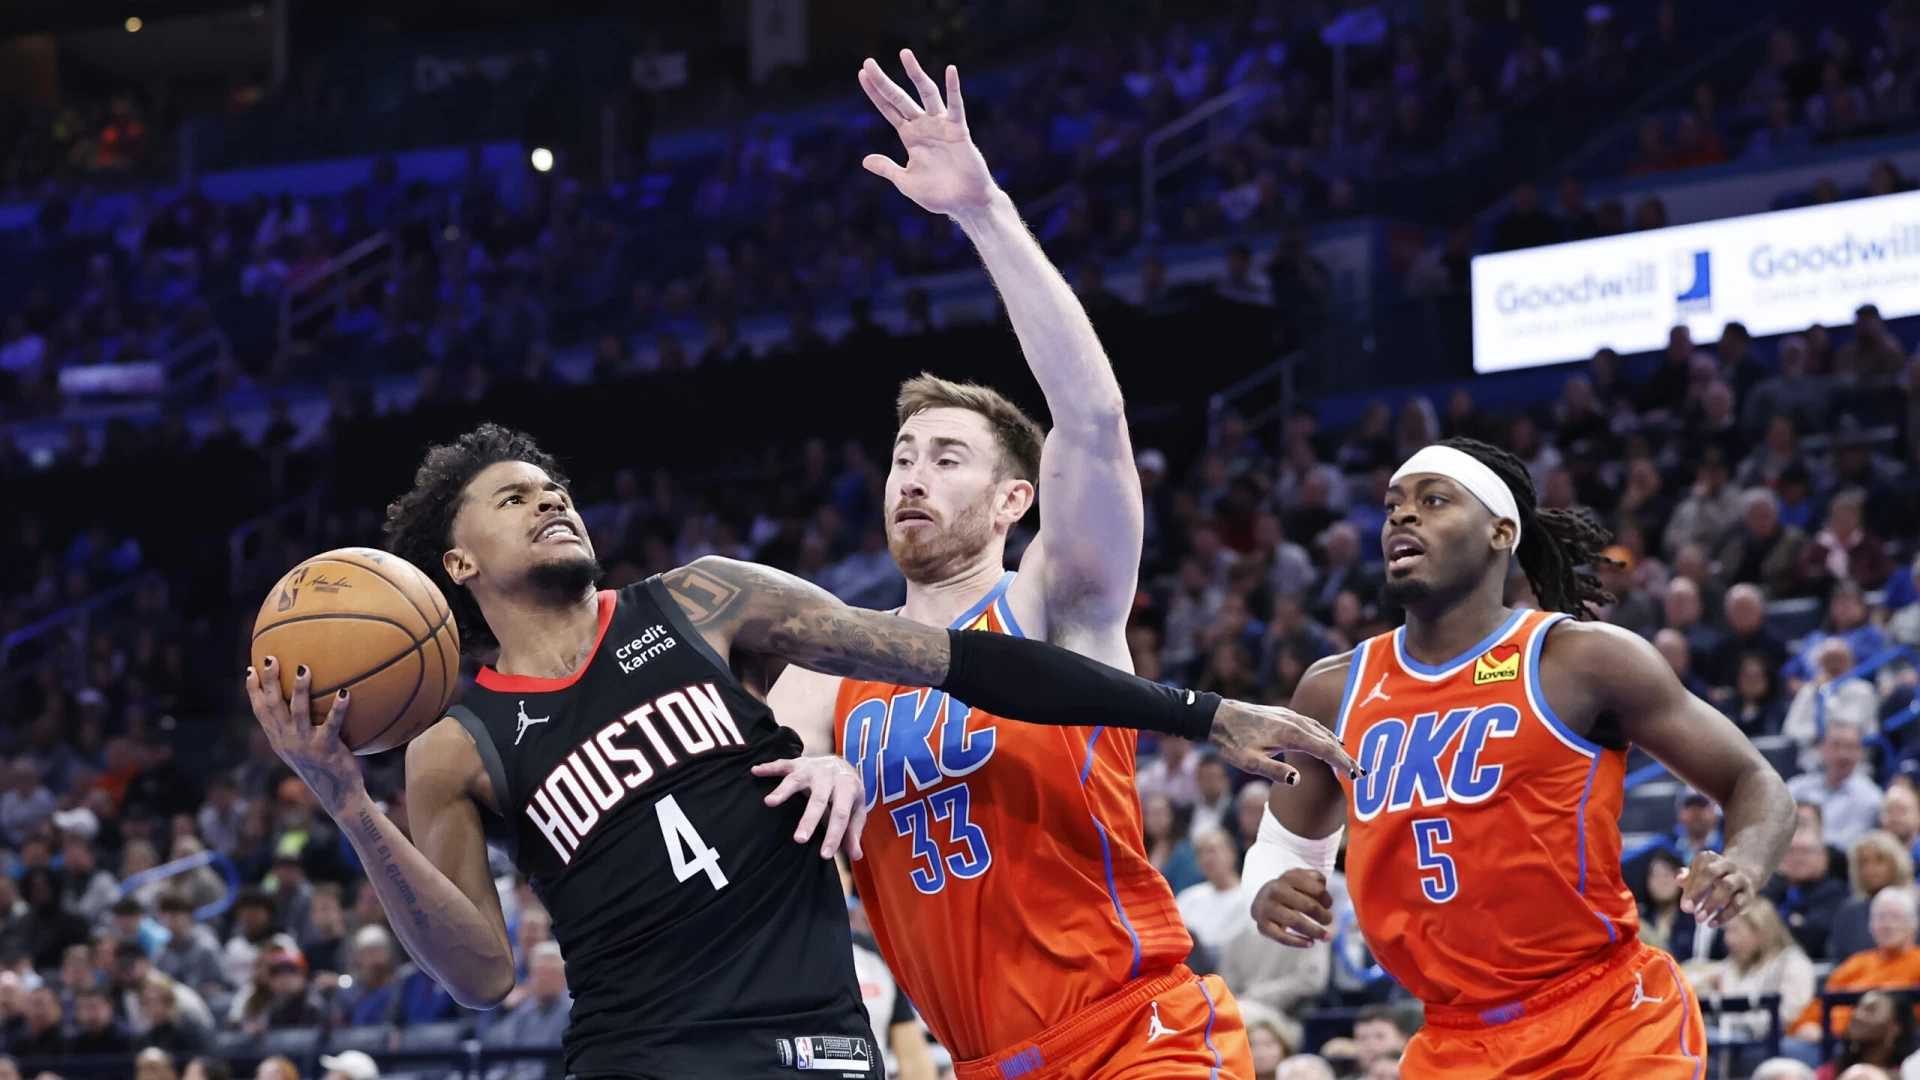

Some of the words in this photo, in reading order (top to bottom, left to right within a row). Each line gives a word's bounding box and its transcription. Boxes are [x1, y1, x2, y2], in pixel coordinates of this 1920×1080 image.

[1494, 259, 1657, 315] Goodwill
[1748, 220, 1920, 280] Goodwill
[616, 624, 667, 659] credit
[618, 637, 676, 674] karma
[525, 682, 747, 865] HOUSTON
[842, 687, 997, 814] OKC
[1353, 703, 1521, 821] OKC
[654, 794, 729, 890] 4
[890, 783, 992, 894] 33
[1412, 818, 1458, 903] 5
